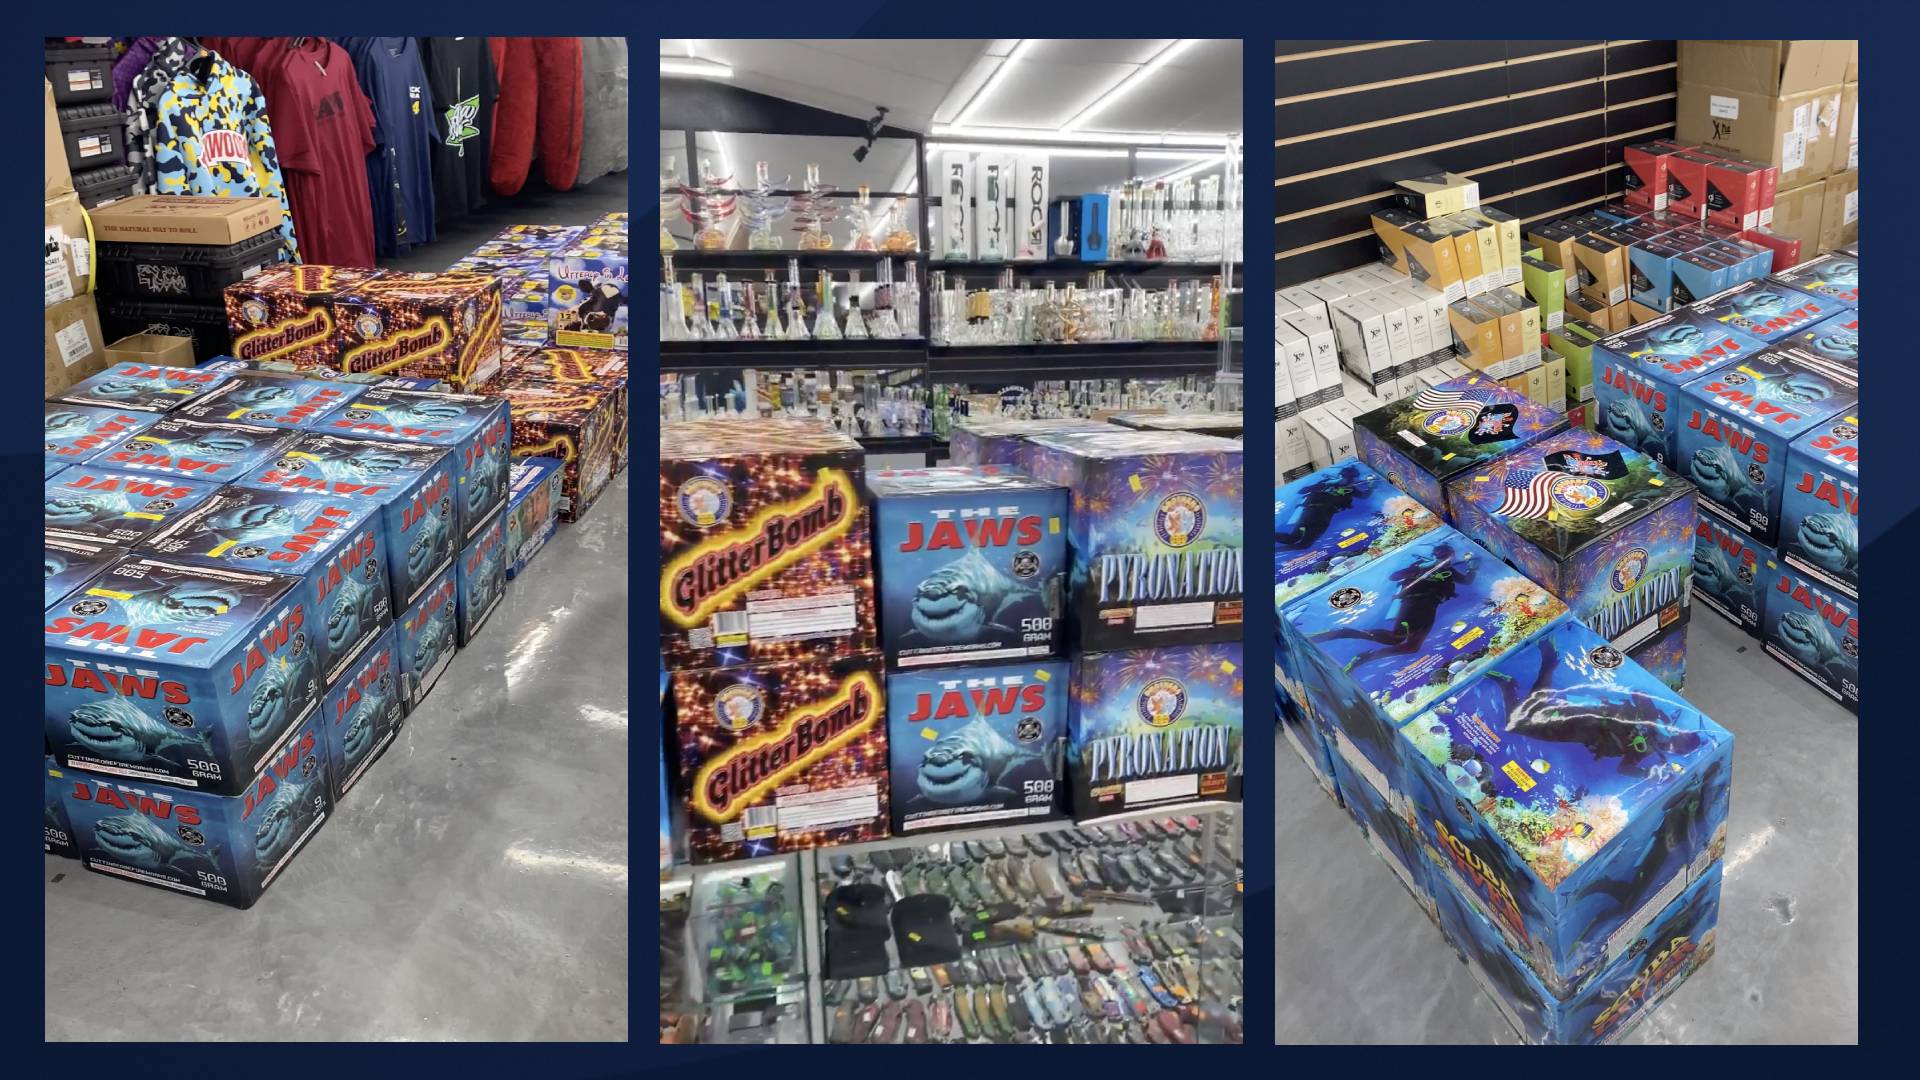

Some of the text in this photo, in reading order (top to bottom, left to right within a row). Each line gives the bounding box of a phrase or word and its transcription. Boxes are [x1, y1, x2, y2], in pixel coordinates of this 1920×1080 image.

[1752, 303, 1823, 335] JAWS
[1663, 338, 1743, 374] JAWS
[119, 366, 217, 382] JAWS
[1615, 364, 1656, 388] THE
[1601, 367, 1667, 412] JAWS
[1703, 381, 1800, 425] JAWS
[1705, 409, 1755, 439] THE
[1712, 396, 1766, 425] THE
[1688, 410, 1769, 464] JAWS
[106, 452, 233, 474] JAWS
[1657, 453, 1664, 464] 9
[64, 476, 193, 499] JAWS
[401, 471, 449, 532] JAWS
[930, 506, 1020, 519] THE
[1750, 509, 1769, 526] 500
[268, 506, 352, 562] JAWS
[900, 516, 1042, 552] JAWS
[1696, 522, 1757, 566] AWS
[113, 567, 145, 579] 500
[315, 531, 375, 605] JAWS
[1795, 576, 1851, 615] THE
[1021, 617, 1052, 632] 500
[1740, 604, 1758, 622] 500
[45, 617, 208, 654] JAWS
[243, 606, 290, 652] THE
[1023, 632, 1051, 642] GRAM
[65, 637, 157, 658] THE
[231, 603, 305, 695] JAWS
[66, 658, 160, 678] THE
[938, 676, 1024, 689] THE
[45, 664, 190, 704] JAWS
[307, 679, 316, 691] 9
[335, 648, 391, 725] JAWS
[908, 684, 1046, 722] JAWS
[187, 759, 221, 773] 500
[1090, 724, 1230, 783] PYRONATION
[192, 770, 222, 780] GRAM
[241, 729, 316, 821] JAWS
[1024, 780, 1054, 793] 500
[72, 782, 202, 825] JAWS
[91, 780, 173, 801] THE
[198, 871, 226, 885] 500
[201, 881, 228, 892] GRAM
